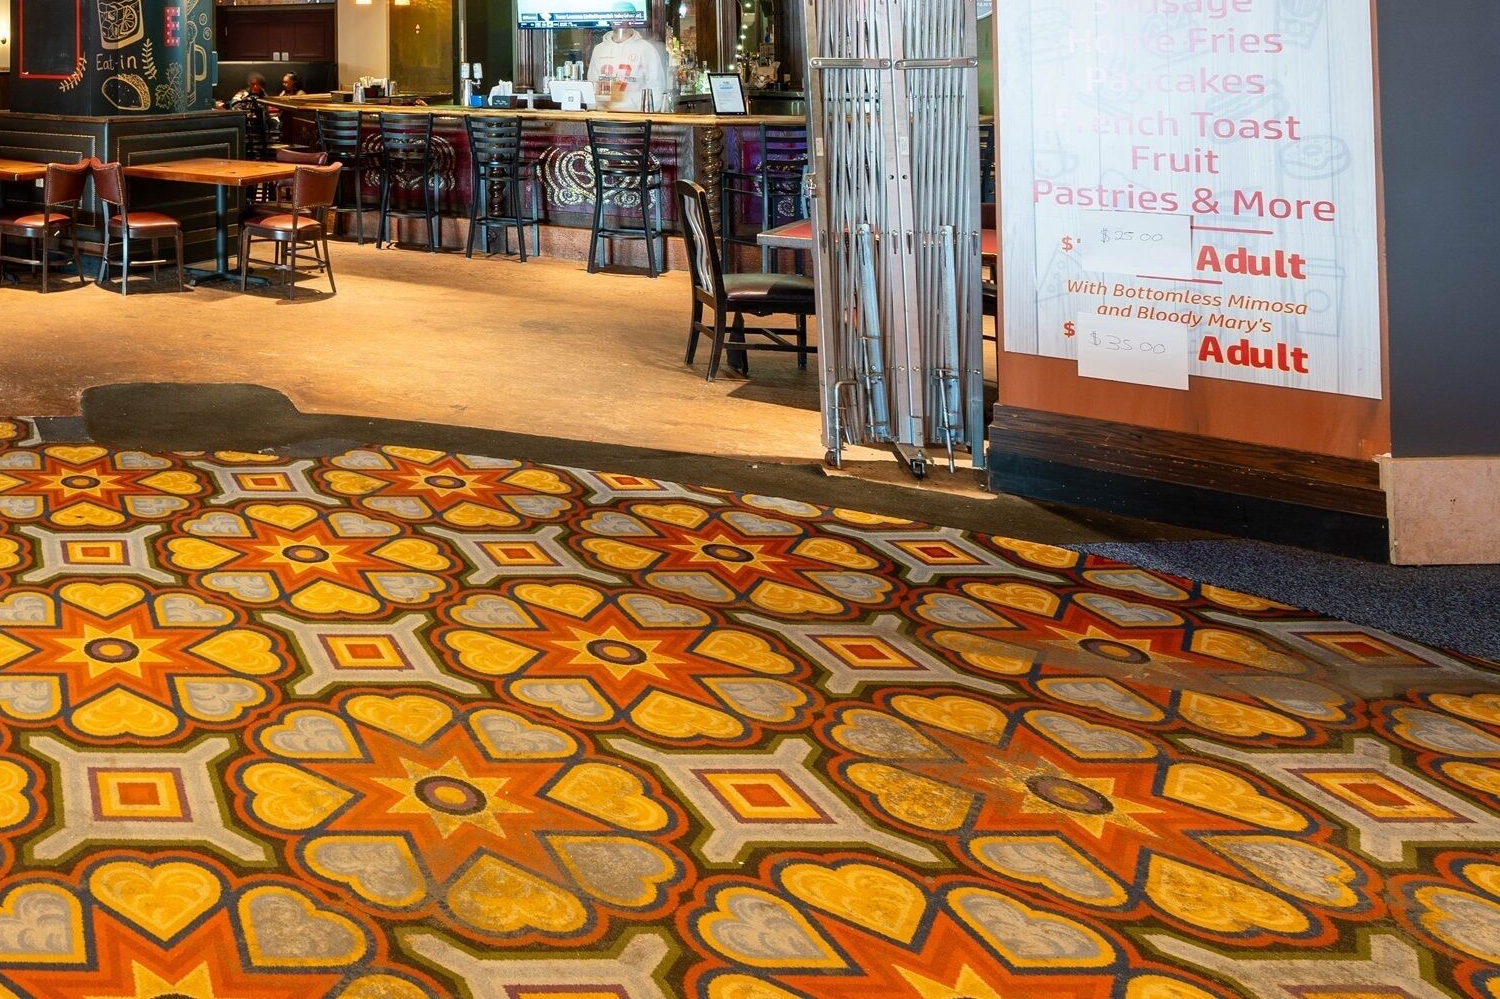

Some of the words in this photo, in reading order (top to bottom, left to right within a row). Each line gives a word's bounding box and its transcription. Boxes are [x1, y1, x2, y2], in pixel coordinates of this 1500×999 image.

[1187, 27, 1283, 54] Fries
[1087, 67, 1265, 94] Pancakes
[1057, 109, 1179, 138] Fench
[1191, 112, 1300, 140] Toast
[1131, 146, 1219, 174] Fruit
[1033, 179, 1179, 212] Pastries
[1191, 187, 1219, 215] &
[1234, 190, 1335, 221] More
[1196, 245, 1306, 279] Adult
[1067, 280, 1107, 296] With
[1113, 284, 1222, 307] Bottomless
[1228, 295, 1307, 316] Mimosa
[1097, 305, 1132, 318] and
[1137, 306, 1202, 328] Bloody
[1208, 313, 1272, 334] Mary's
[1199, 336, 1309, 374] Adult
